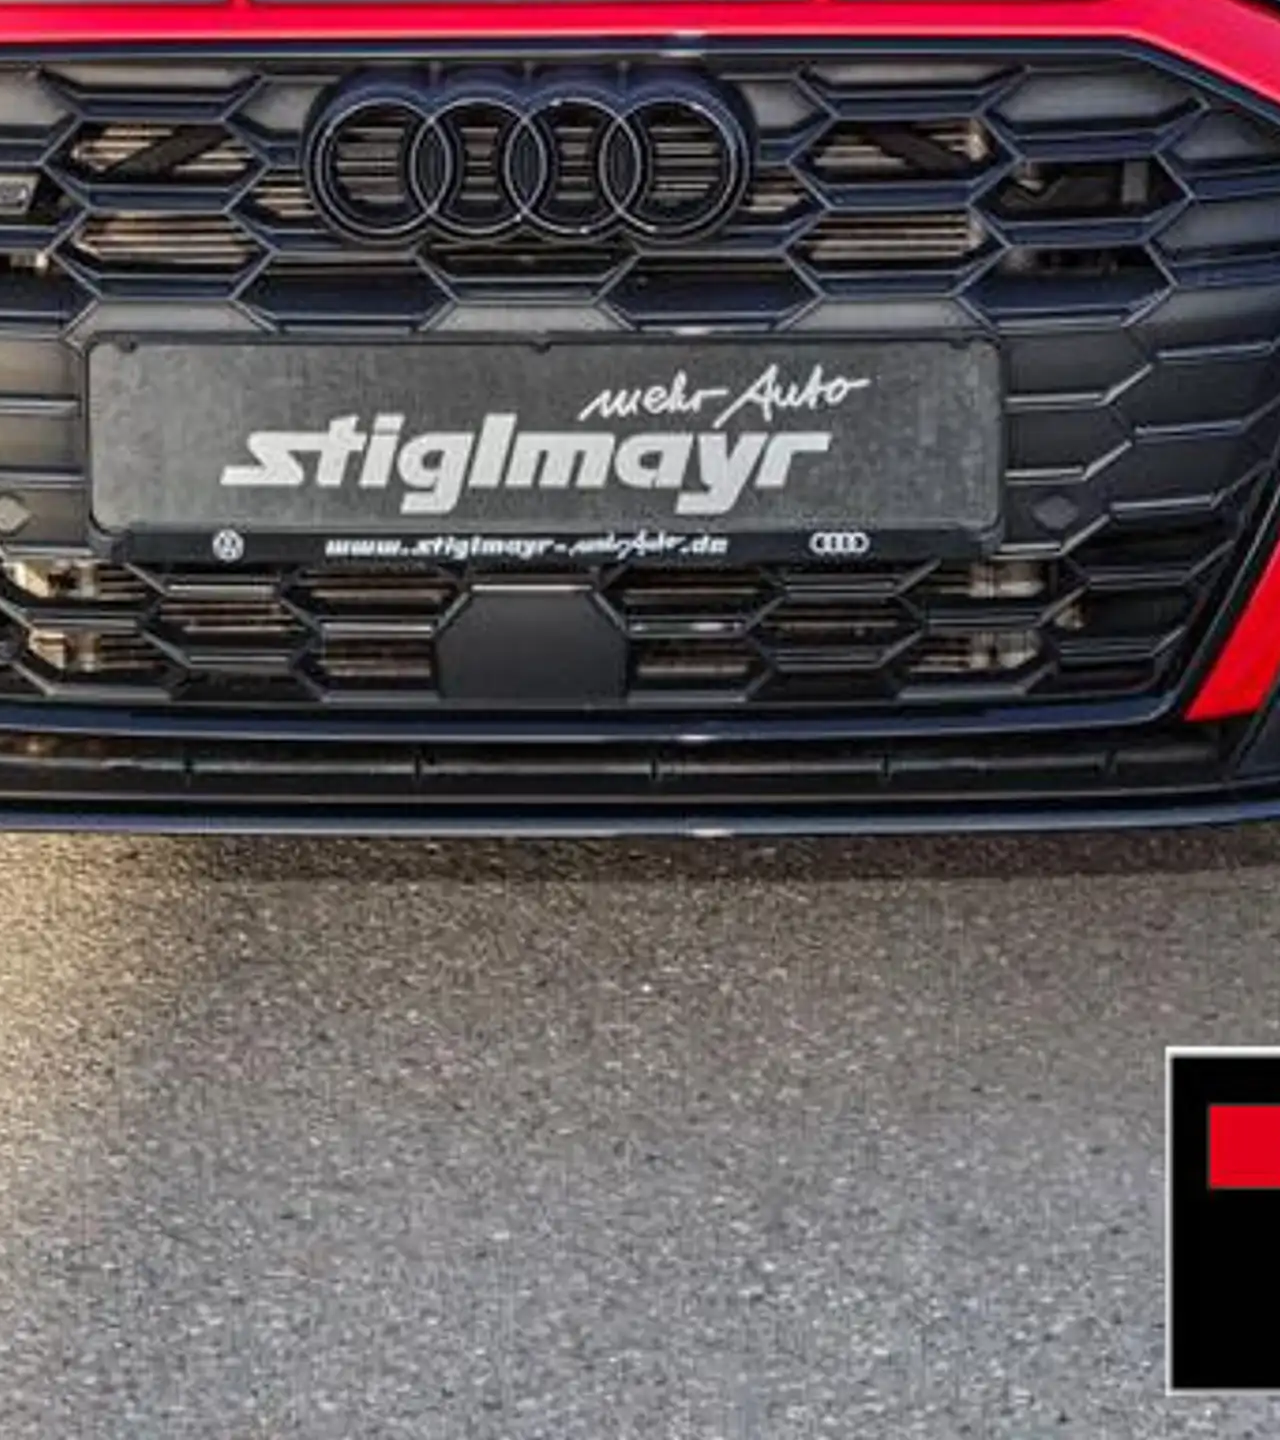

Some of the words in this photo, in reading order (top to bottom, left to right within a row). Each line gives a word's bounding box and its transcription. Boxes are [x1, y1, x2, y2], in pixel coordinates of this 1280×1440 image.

[577, 370, 728, 421] mehr
[712, 363, 871, 428] Auto
[219, 414, 832, 513] stiglmayr
